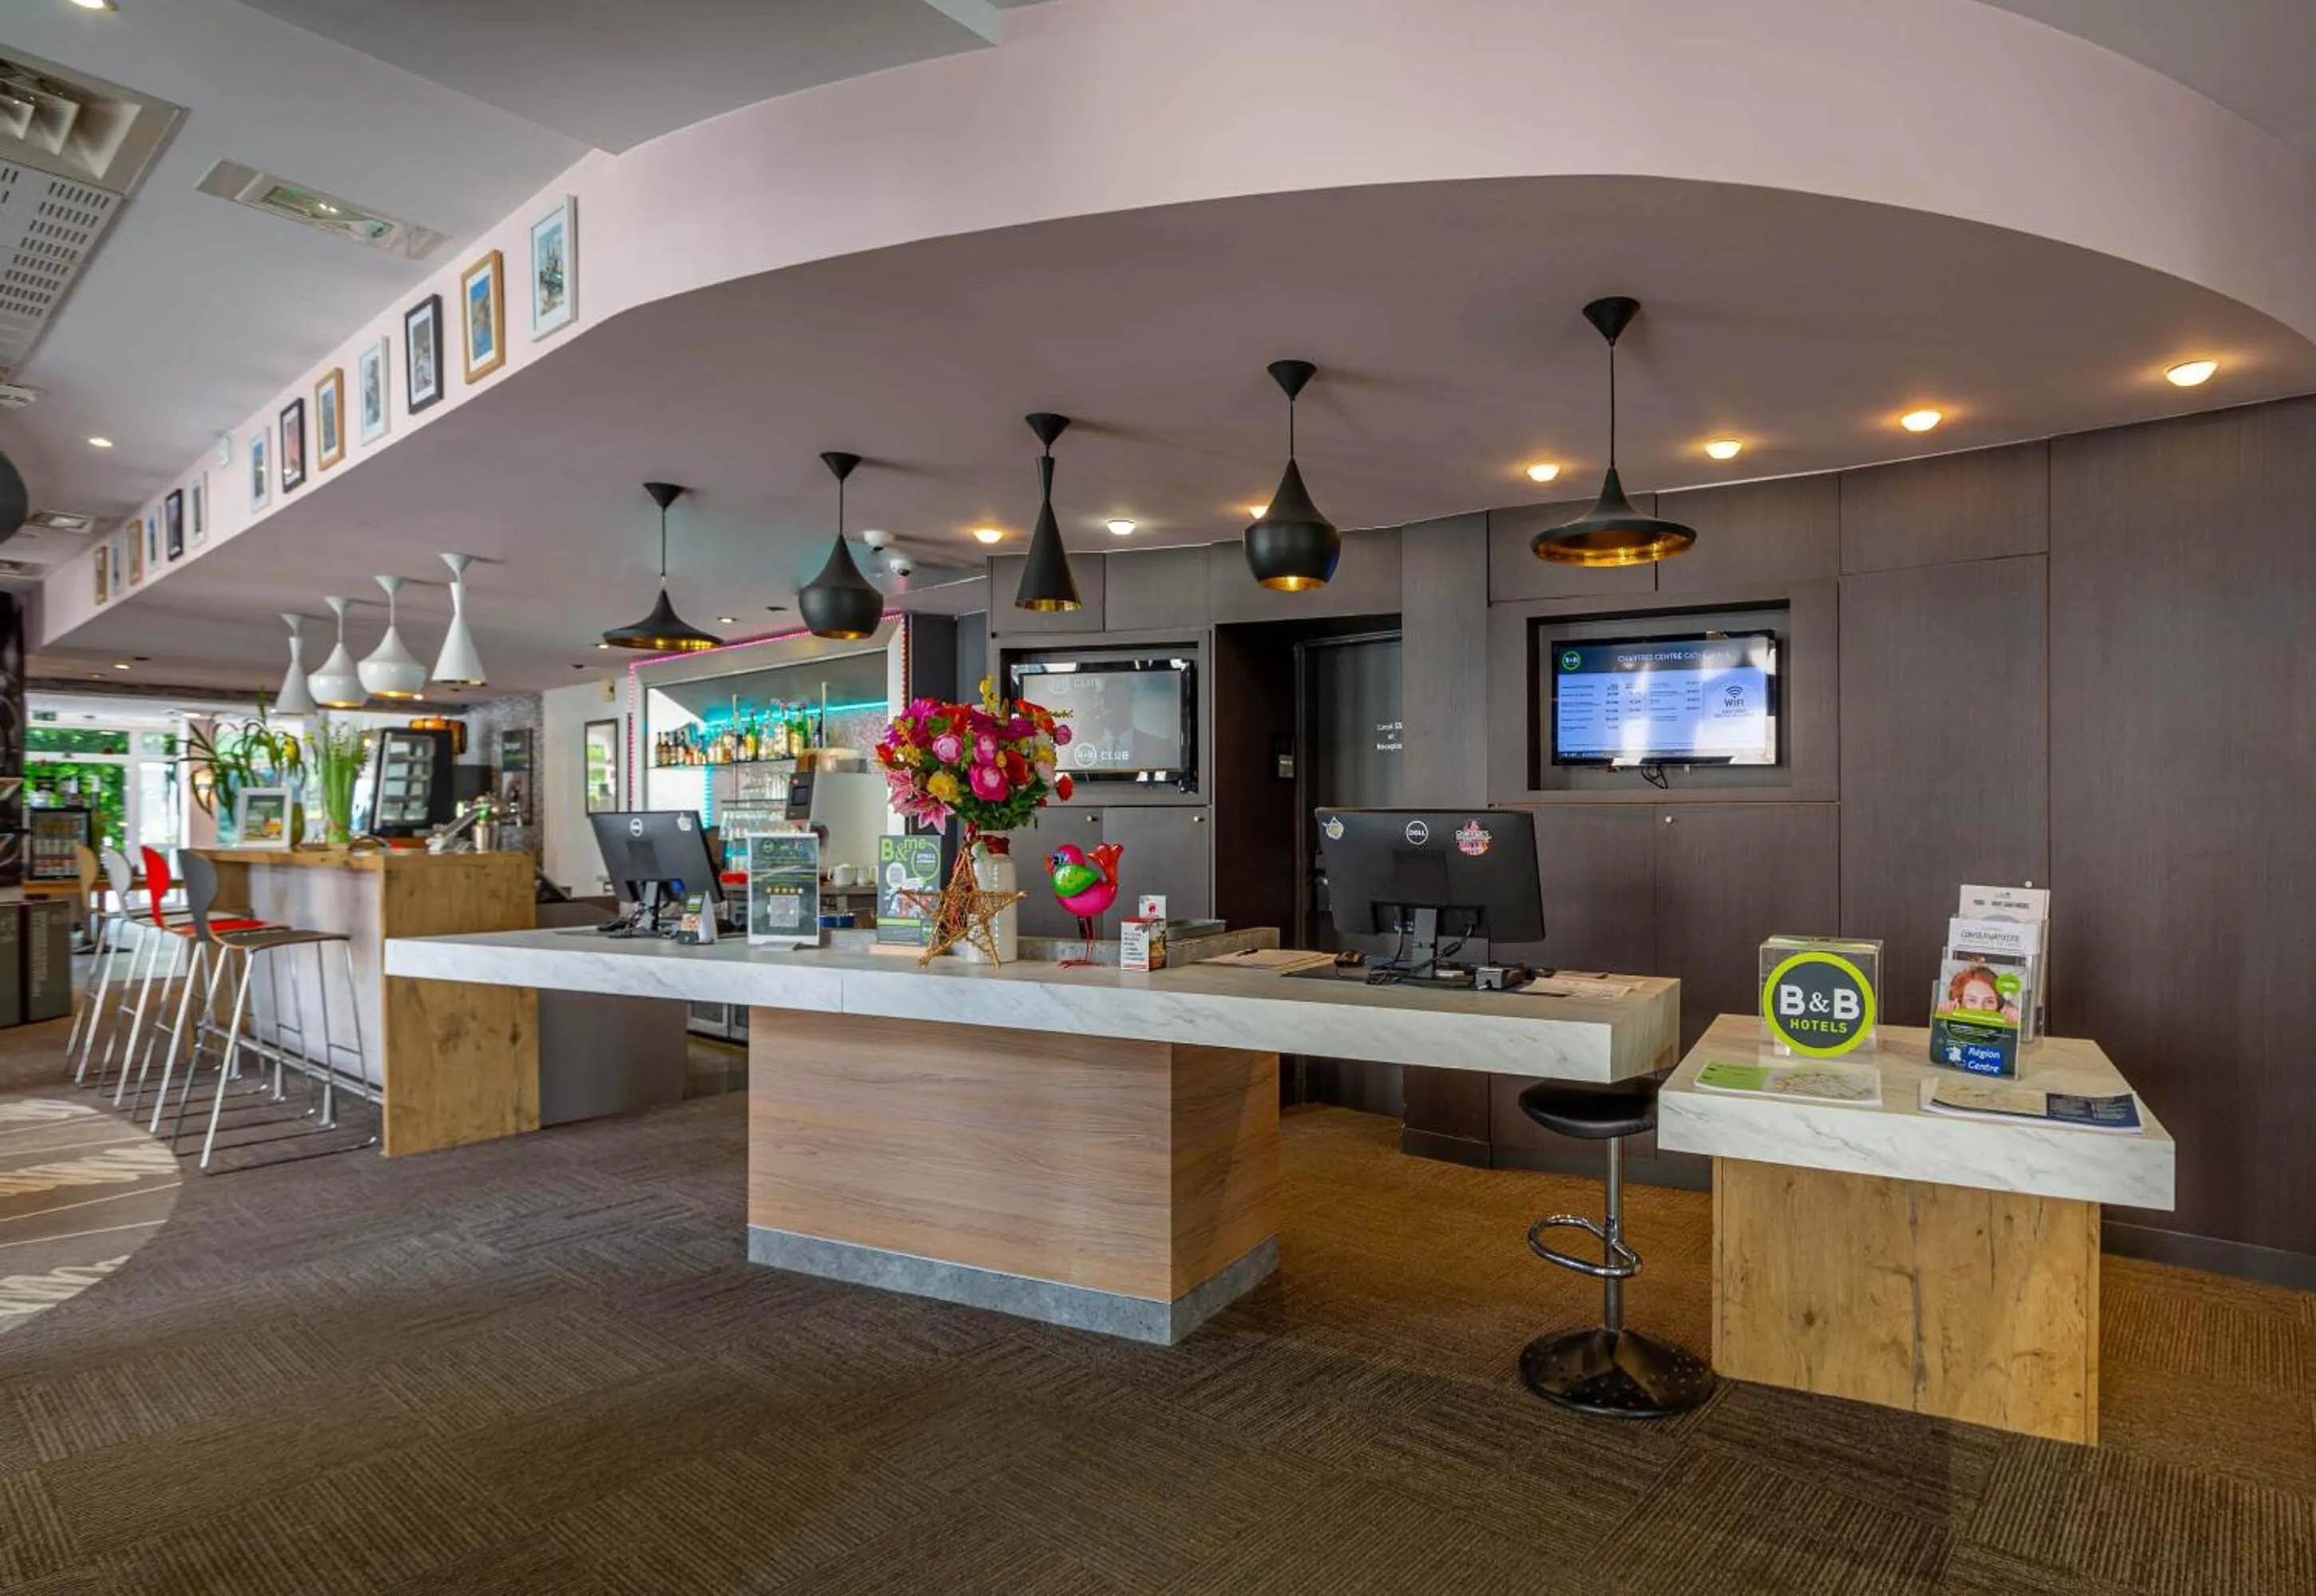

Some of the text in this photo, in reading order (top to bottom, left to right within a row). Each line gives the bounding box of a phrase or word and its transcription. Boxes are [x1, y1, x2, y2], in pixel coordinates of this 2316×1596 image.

[1790, 1018, 1848, 1033] HOTELS
[1968, 1047, 2001, 1059] Région
[1967, 1060, 2000, 1073] Centre
